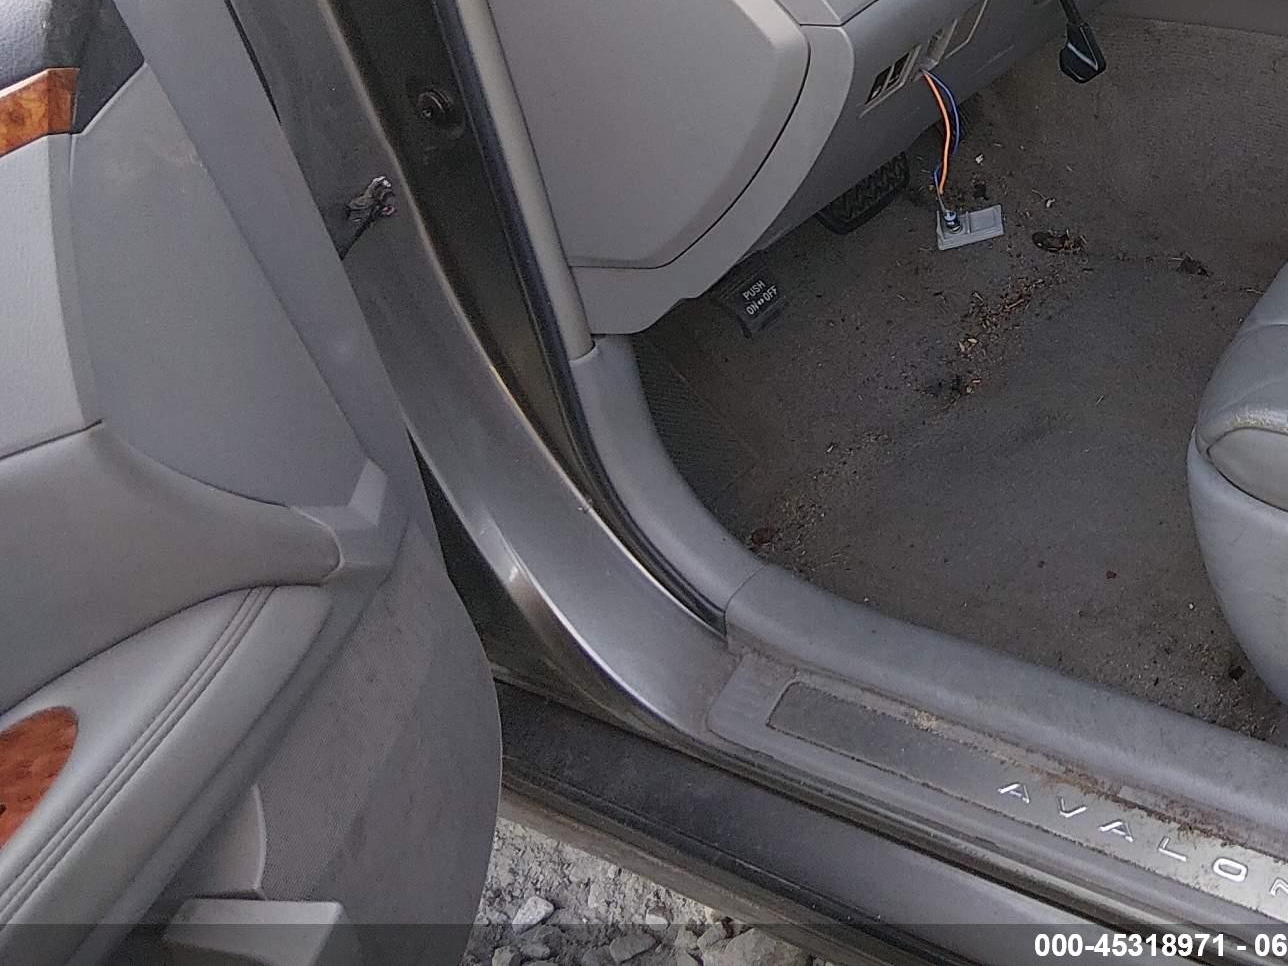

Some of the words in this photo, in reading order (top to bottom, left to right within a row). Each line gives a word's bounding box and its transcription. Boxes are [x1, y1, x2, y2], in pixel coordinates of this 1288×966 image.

[742, 280, 766, 301] PUSH
[746, 301, 759, 315] ON
[763, 285, 777, 301] OFF
